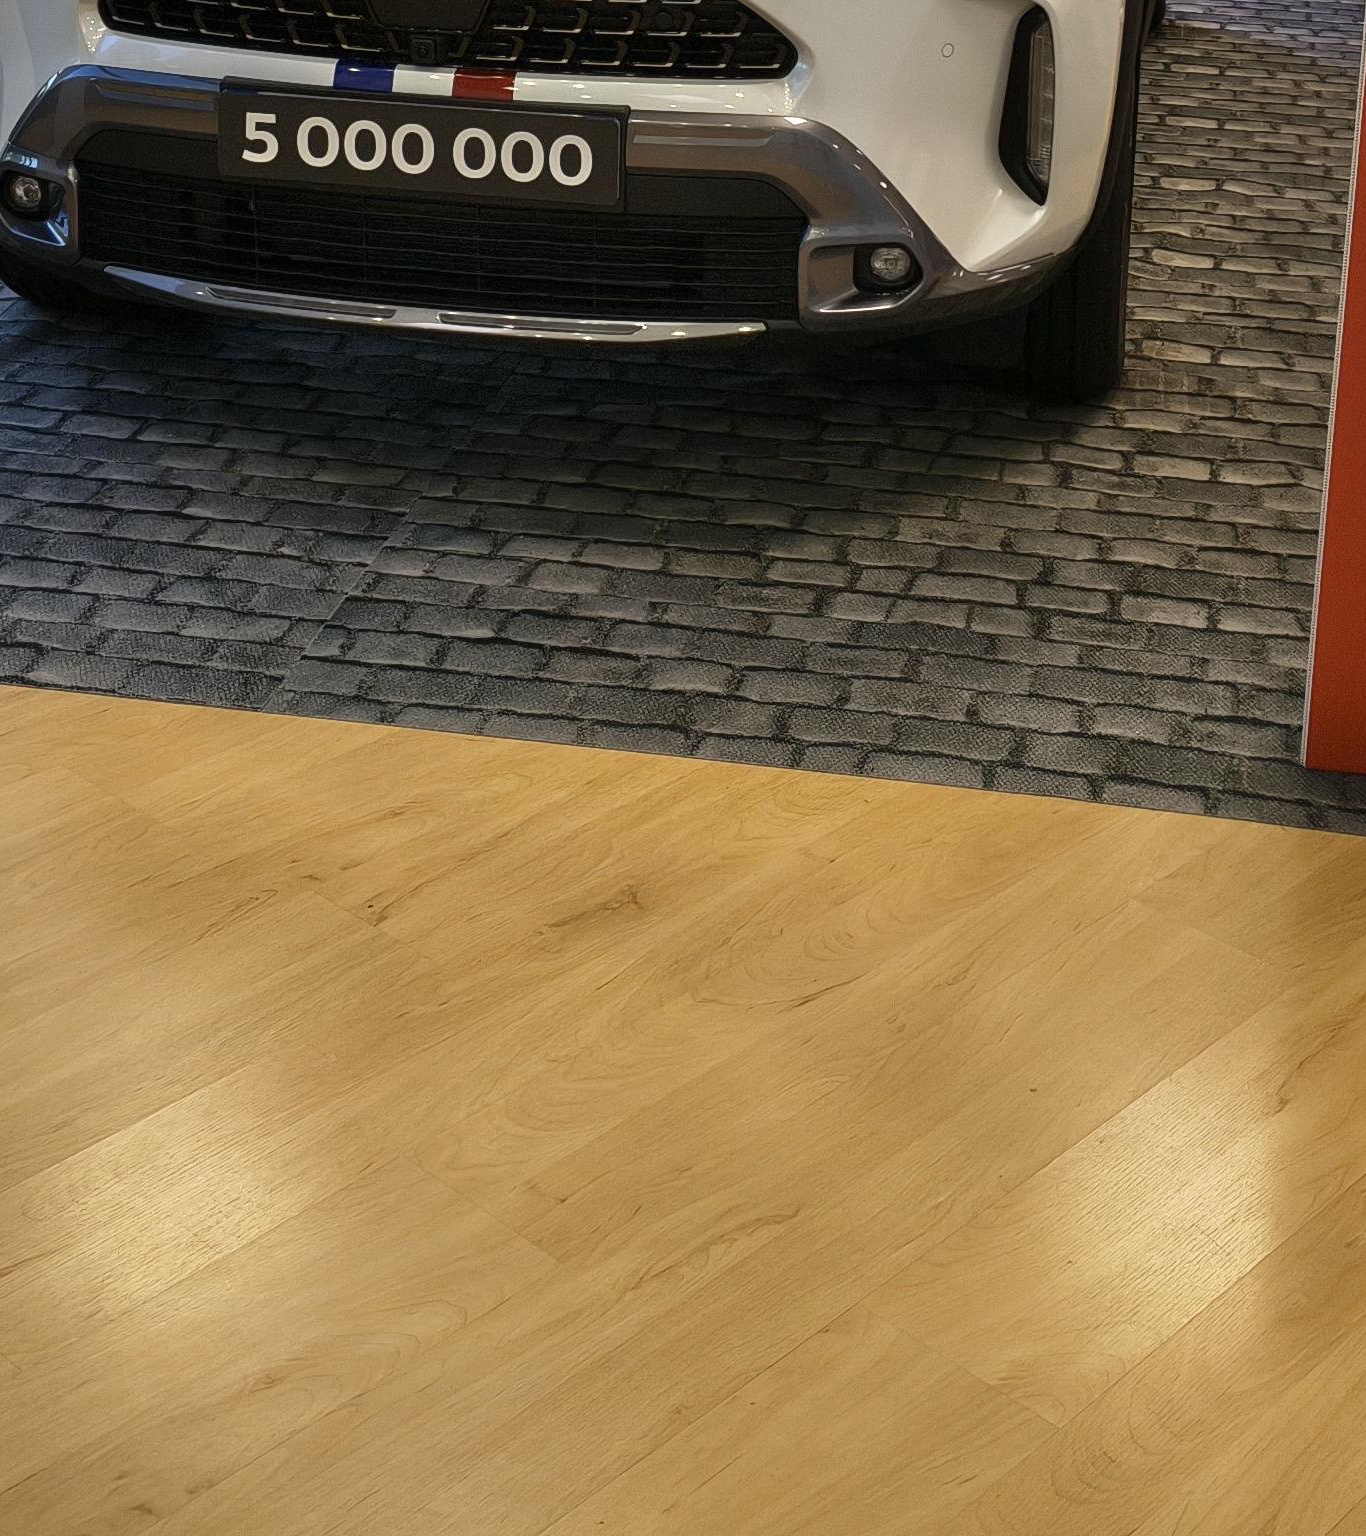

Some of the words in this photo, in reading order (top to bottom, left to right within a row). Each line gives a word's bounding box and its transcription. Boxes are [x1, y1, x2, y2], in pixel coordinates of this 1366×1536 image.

[241, 111, 279, 163] 5
[296, 116, 435, 175] 000
[452, 127, 593, 187] 000
